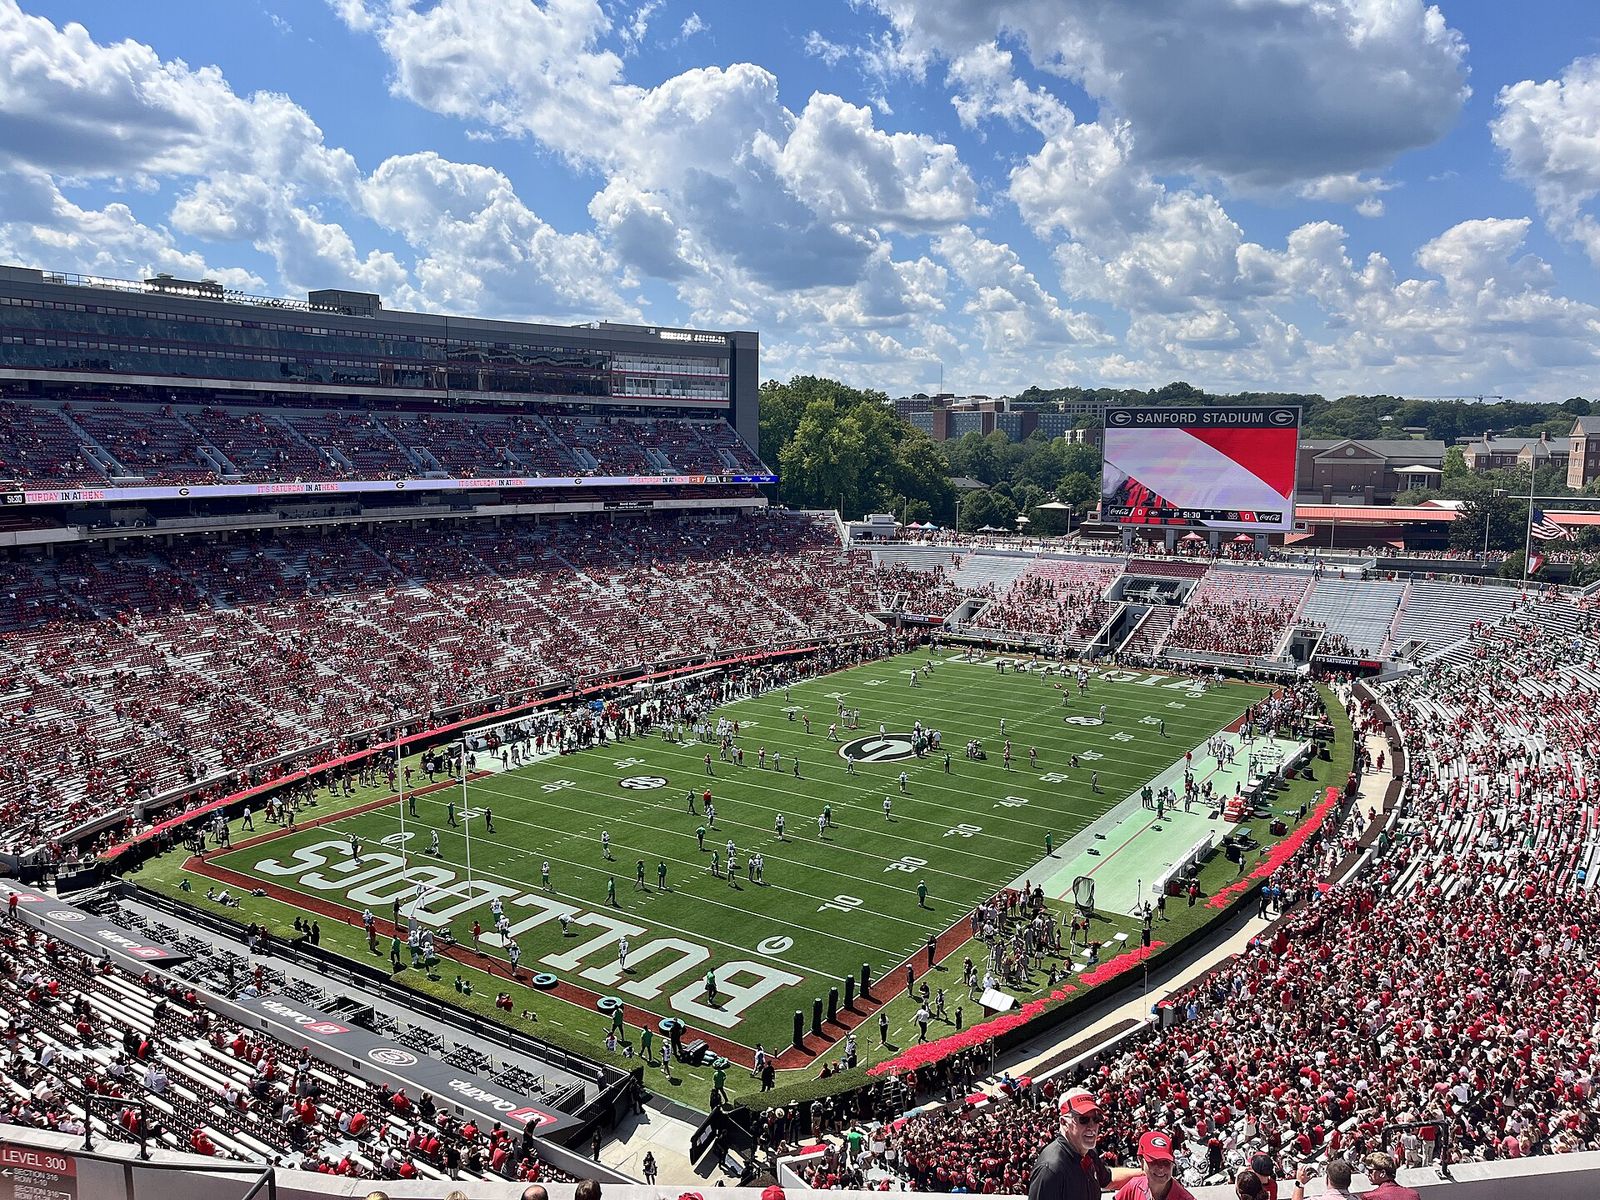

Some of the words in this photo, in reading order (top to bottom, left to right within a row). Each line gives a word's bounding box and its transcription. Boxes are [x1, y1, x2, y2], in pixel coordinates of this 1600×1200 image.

[1136, 413, 1196, 423] SANFORD
[1203, 413, 1263, 423] STADIUM
[26, 491, 58, 502] TURDAY
[61, 492, 71, 501] IN
[72, 490, 104, 500] ATHENS
[179, 488, 189, 496] G
[1183, 511, 1201, 519] 51:30
[890, 856, 929, 873] 20
[824, 894, 864, 912] 10
[253, 840, 804, 1029] BULLDOGS
[2, 1149, 43, 1166] LEVEL
[44, 1156, 67, 1170] 300
[13, 1167, 45, 1179] SECTION
[14, 1175, 31, 1183] ROW
[14, 1184, 46, 1195] SECTION
